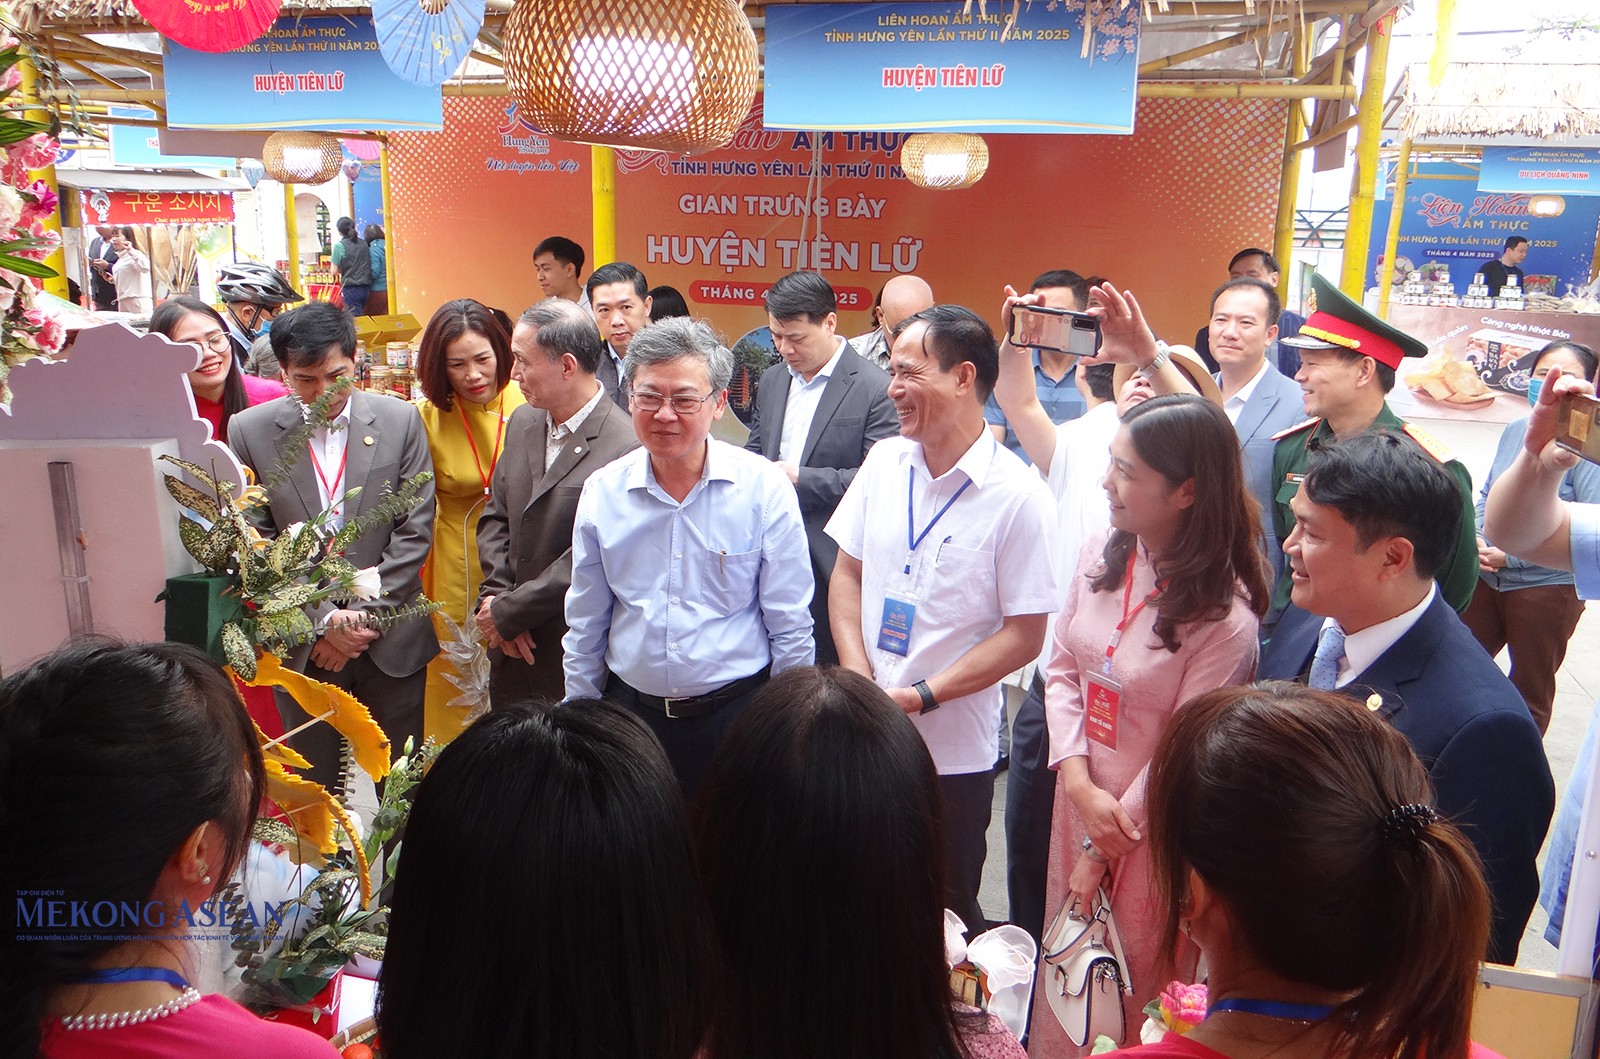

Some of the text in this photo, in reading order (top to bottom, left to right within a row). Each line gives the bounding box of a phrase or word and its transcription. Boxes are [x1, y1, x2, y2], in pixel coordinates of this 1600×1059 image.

[878, 13, 907, 26] LIÊN
[910, 15, 949, 26] HOAN
[824, 29, 854, 42] TỈNH
[858, 30, 895, 42] HƯNG
[899, 29, 926, 42] YÊN
[959, 28, 987, 41] THỨ
[990, 30, 998, 41] II
[1036, 29, 1070, 40] 2025
[339, 40, 362, 51] NĂM
[254, 71, 345, 94] HUYỆN TIÊN LỮ
[882, 63, 1005, 91] HUYỆN TIÊN LỮ
[671, 156, 707, 175] TỈNH
[711, 160, 757, 176] HƯNG
[762, 159, 793, 177] YÊN
[836, 160, 871, 178] THỨ
[124, 193, 163, 213] 구운
[169, 193, 221, 213] 소시지
[679, 192, 887, 219] GIAN TRƯNG BÀY
[1490, 219, 1530, 232] THỰC
[1411, 235, 1438, 244] HƯNG
[1440, 235, 1459, 245] YÊN
[1534, 240, 1558, 248] 2025
[646, 229, 923, 273] HUYỆN TIÊN LỮ
[1426, 249, 1451, 257] THÁNG
[700, 284, 755, 300] THÁNG
[1481, 316, 1504, 329] Công
[1504, 322, 1528, 333] nghệ
